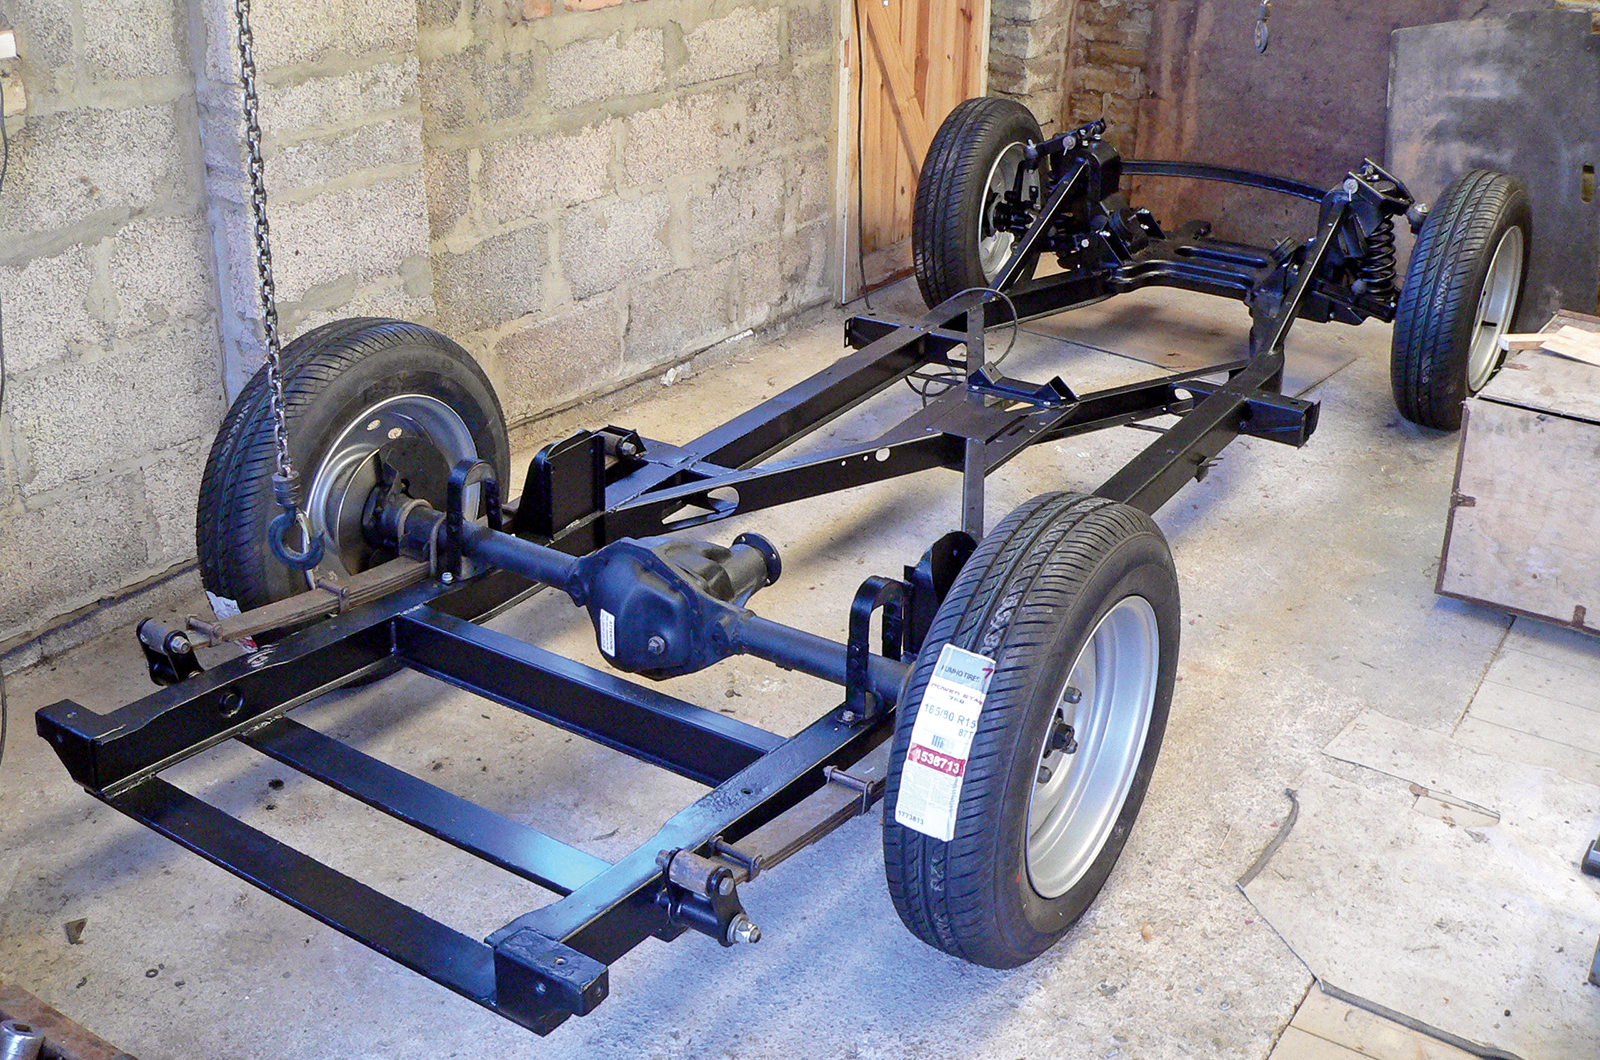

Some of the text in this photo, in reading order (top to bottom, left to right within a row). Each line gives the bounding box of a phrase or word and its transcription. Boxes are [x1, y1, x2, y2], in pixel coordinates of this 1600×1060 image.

[924, 703, 977, 729] 165/80 R15
[958, 728, 974, 739] 87T
[915, 748, 961, 774] 1538713
[898, 810, 924, 825] 1773813
